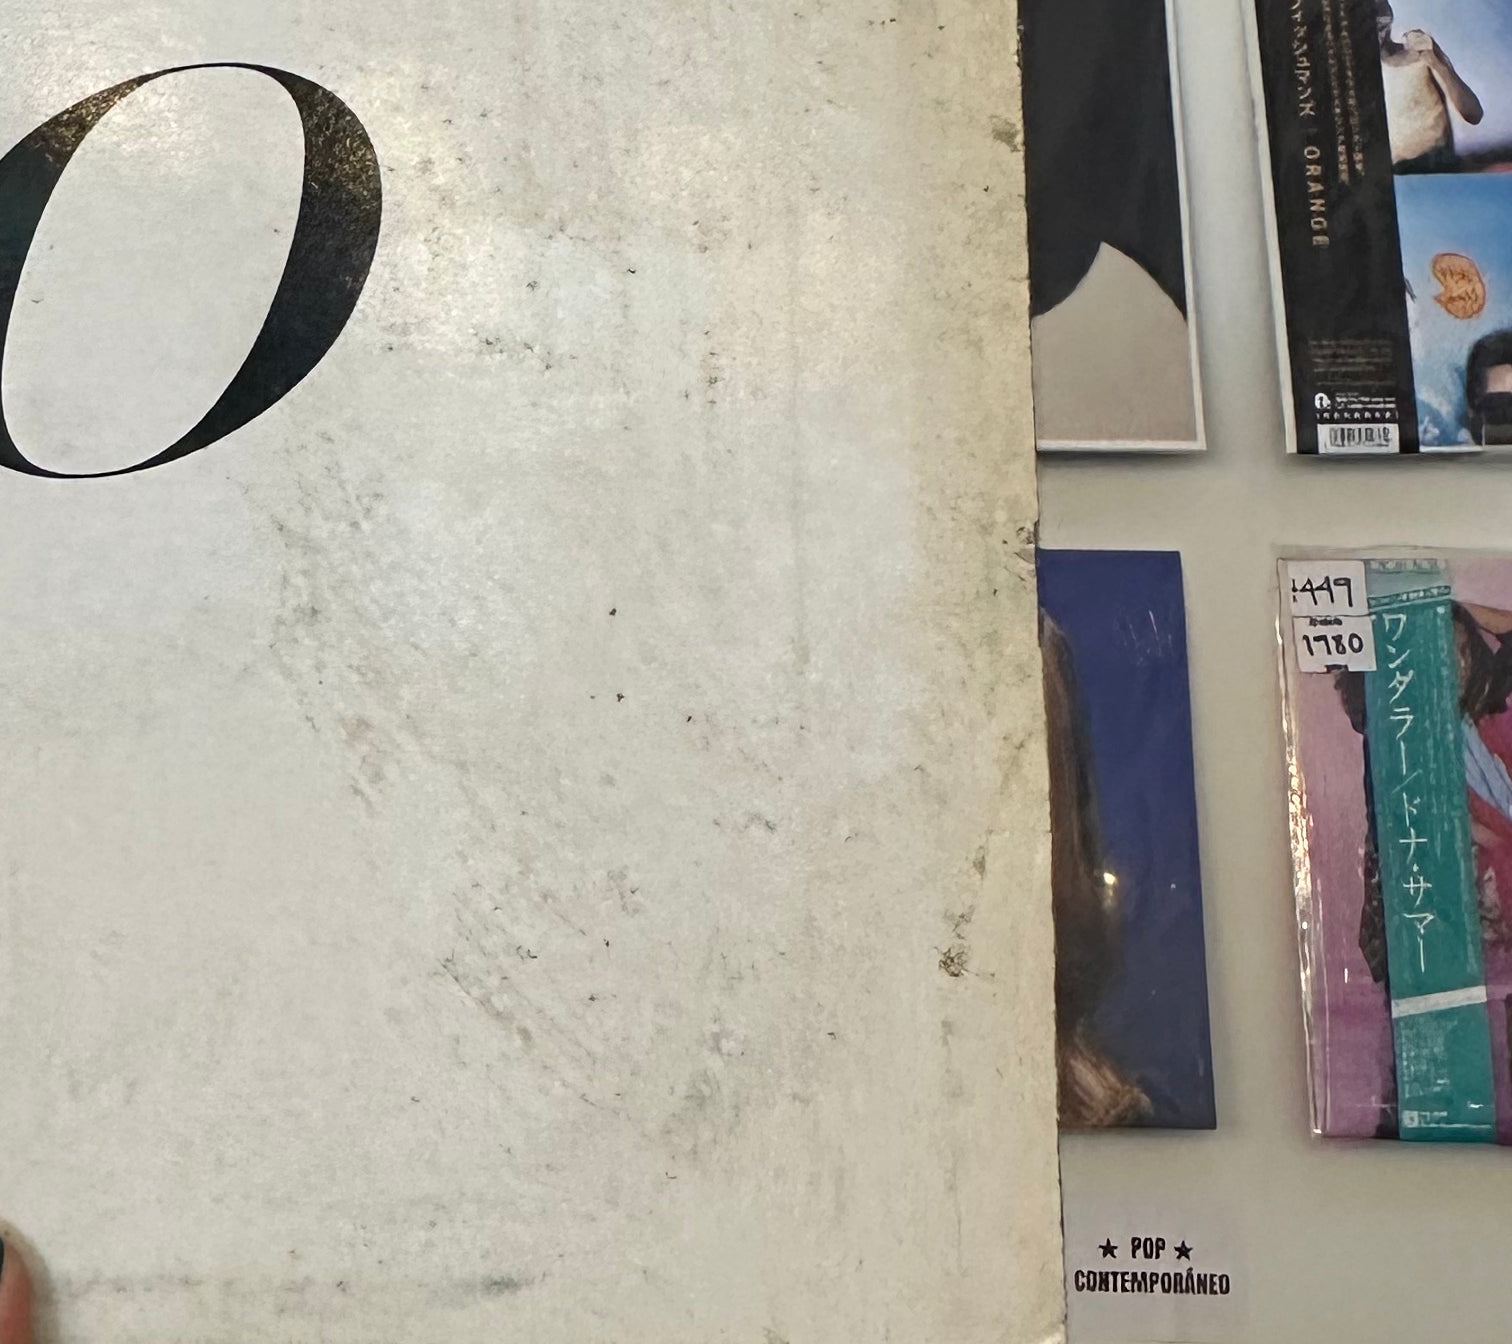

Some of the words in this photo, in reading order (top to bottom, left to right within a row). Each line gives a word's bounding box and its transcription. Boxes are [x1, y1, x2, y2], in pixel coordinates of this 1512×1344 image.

[1304, 145, 1331, 249] ORANGE
[1130, 1236, 1166, 1259] POP
[1074, 1266, 1231, 1296] CONTEMPORÁNEO
